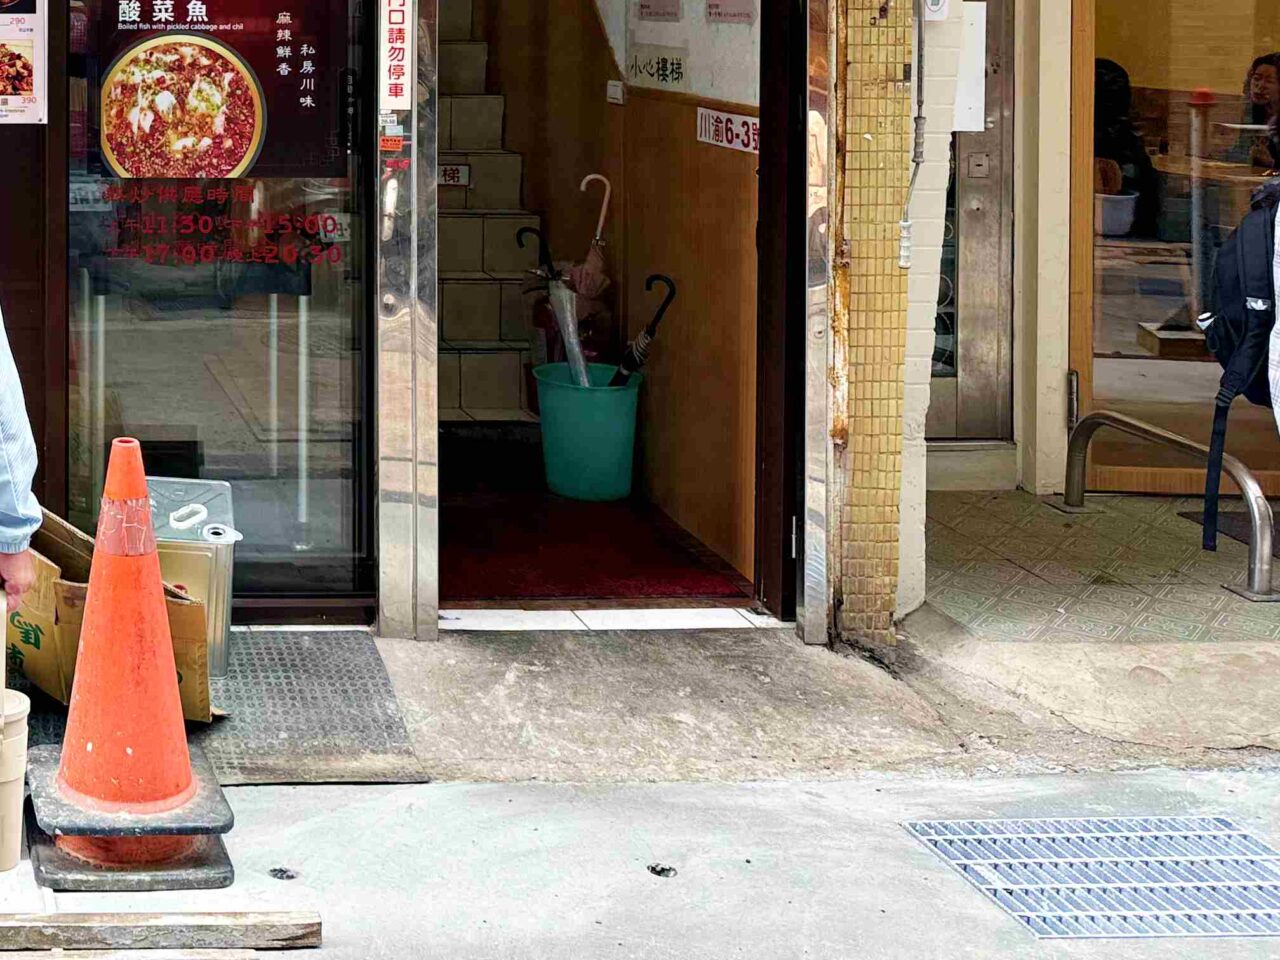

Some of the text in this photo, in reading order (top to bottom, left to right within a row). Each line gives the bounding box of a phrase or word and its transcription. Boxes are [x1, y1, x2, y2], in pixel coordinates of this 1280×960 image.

[9, 17, 26, 25] 290
[117, 0, 209, 22] 酸菜魚
[167, 23, 189, 31] pickled
[190, 23, 218, 31] cabbage
[276, 11, 293, 77] 麻辣鮮香
[299, 43, 316, 108] 私房川味
[630, 54, 684, 84] 小心樓梯
